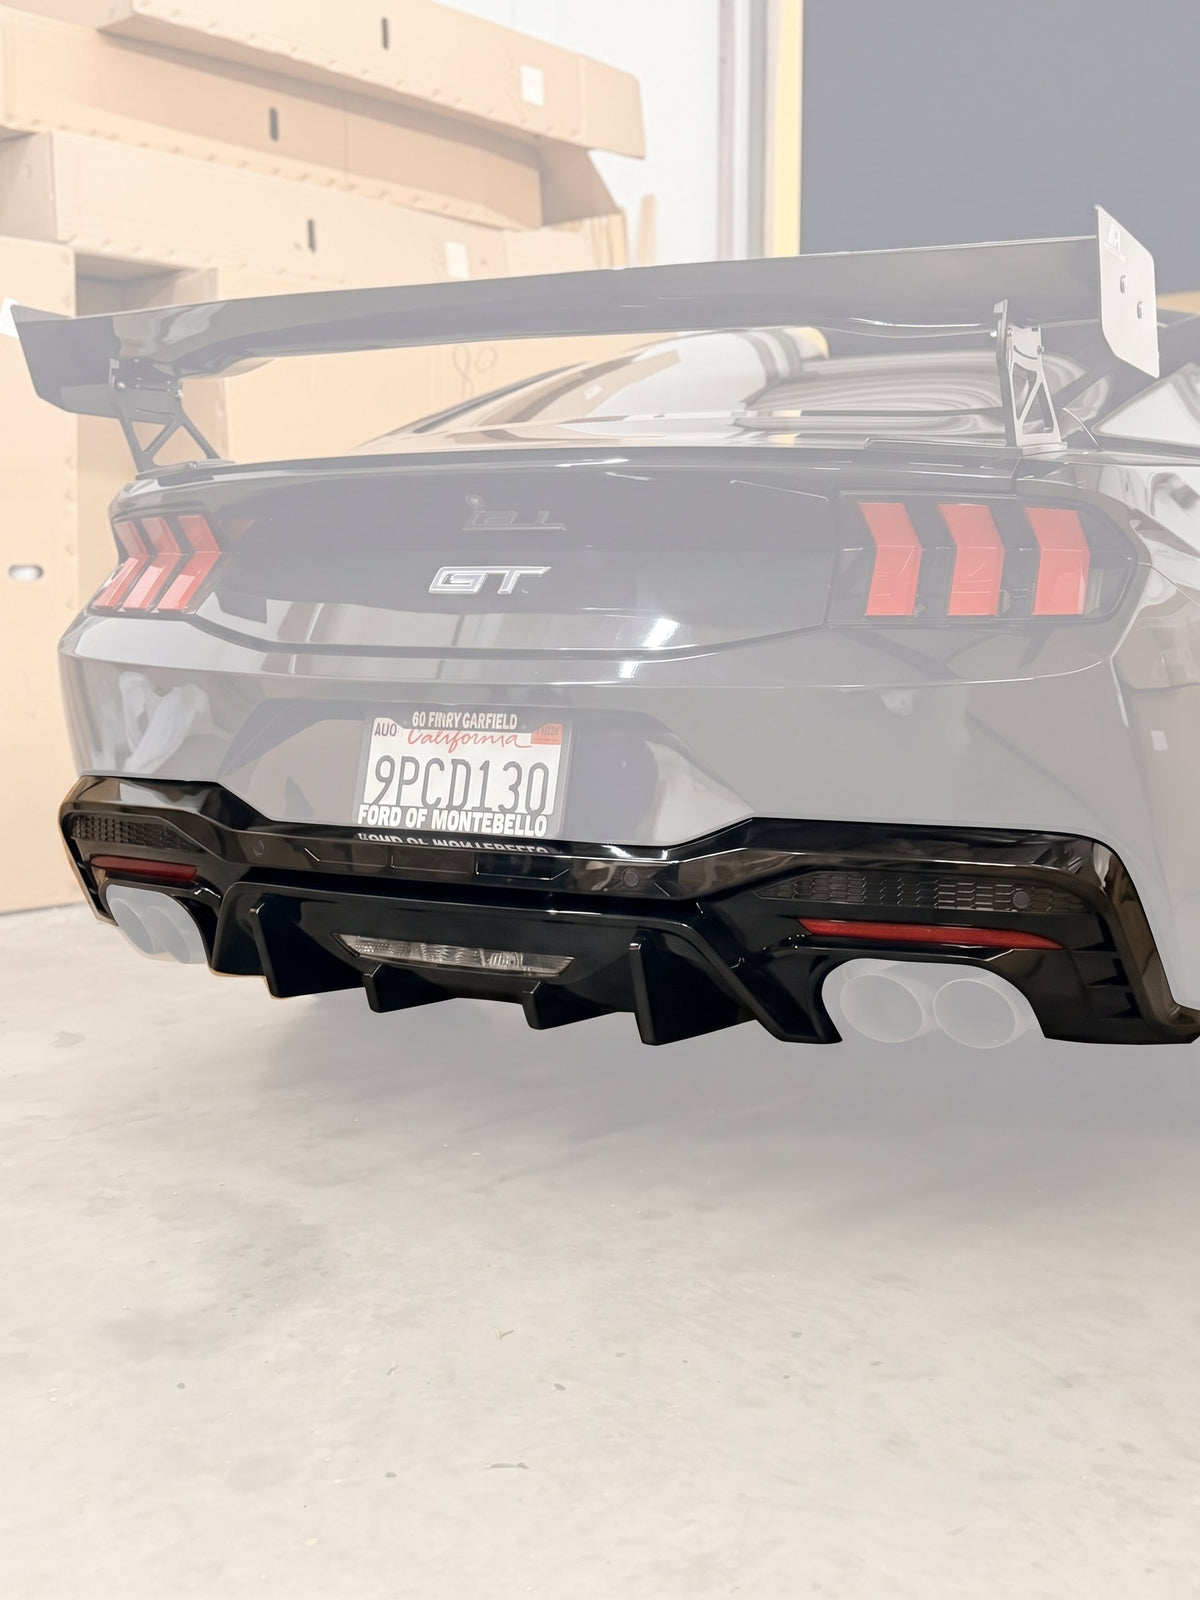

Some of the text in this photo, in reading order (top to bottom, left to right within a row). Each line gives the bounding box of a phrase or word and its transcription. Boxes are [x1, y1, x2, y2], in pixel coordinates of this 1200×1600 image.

[428, 566, 551, 594] GT
[412, 711, 426, 727] 60
[462, 712, 518, 730] GARFIELD
[407, 728, 532, 753] California
[375, 755, 550, 814] 9PCD130
[358, 803, 548, 837] FORD OF MONTEBELLO
